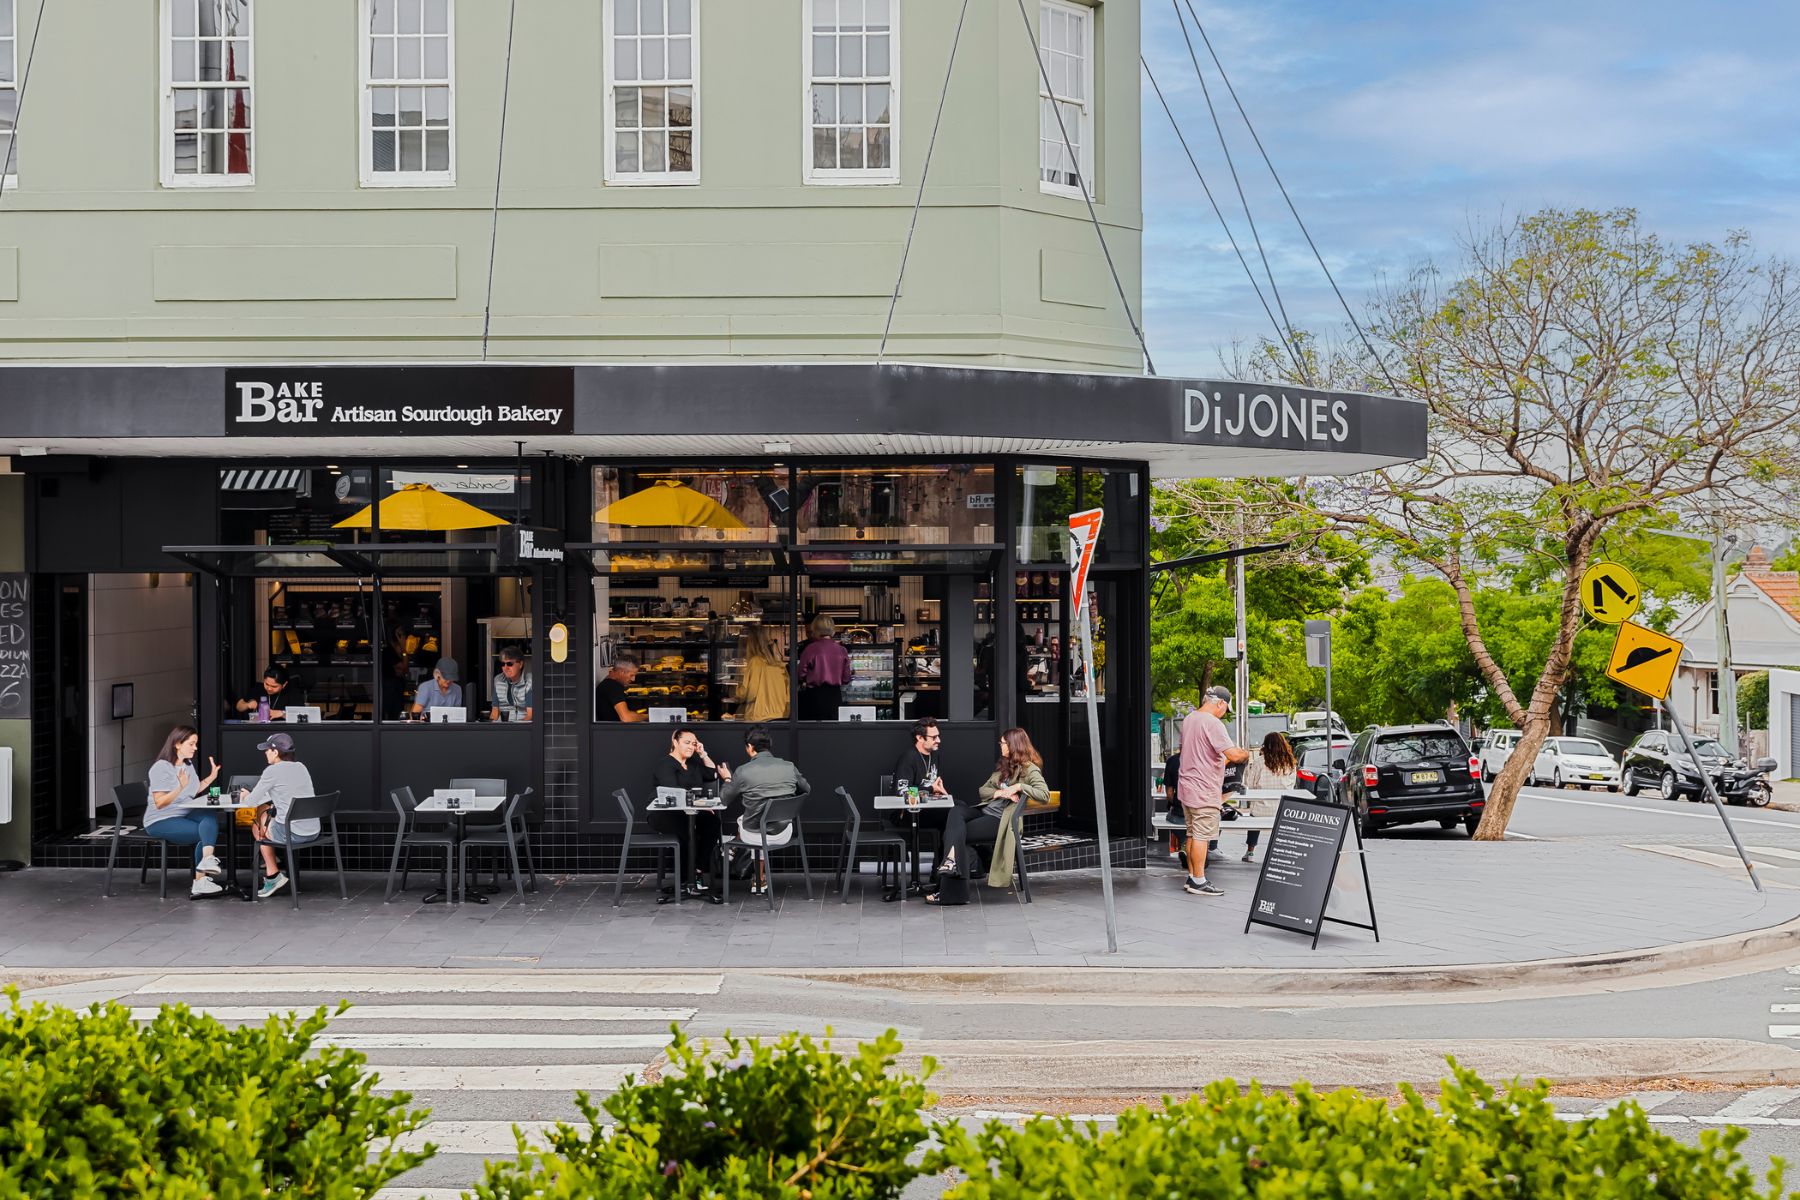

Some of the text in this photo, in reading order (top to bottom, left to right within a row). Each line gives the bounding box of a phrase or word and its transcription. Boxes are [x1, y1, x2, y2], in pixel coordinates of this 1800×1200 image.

[235, 381, 324, 423] Bar
[331, 405, 563, 426] Artisan Sourdough Bakery
[1184, 388, 1349, 442] DiJONES
[1284, 808, 1340, 826] COLD DRINKS
